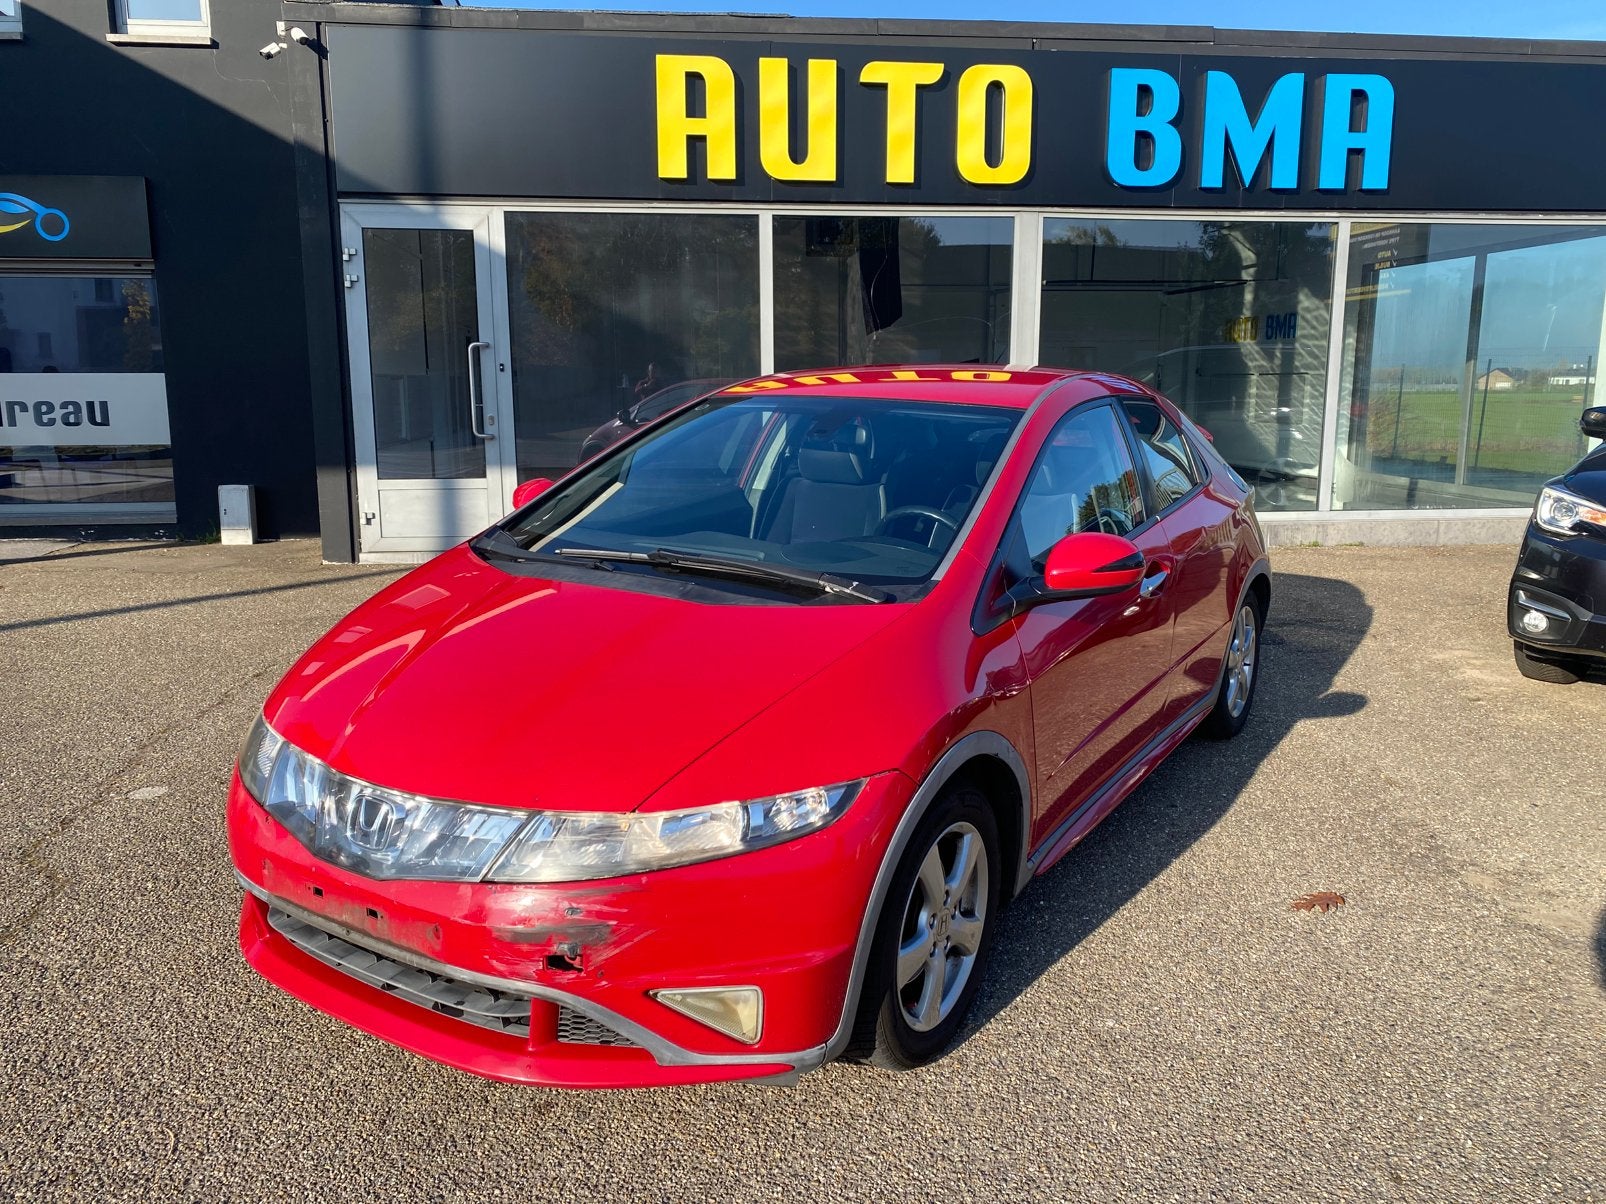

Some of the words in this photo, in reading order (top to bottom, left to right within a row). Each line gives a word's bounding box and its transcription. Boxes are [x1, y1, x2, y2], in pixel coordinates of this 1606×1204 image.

[655, 54, 1034, 186] AUTO
[1107, 68, 1396, 191] BMA
[1265, 313, 1298, 341] BMA
[0, 400, 111, 428] reau
